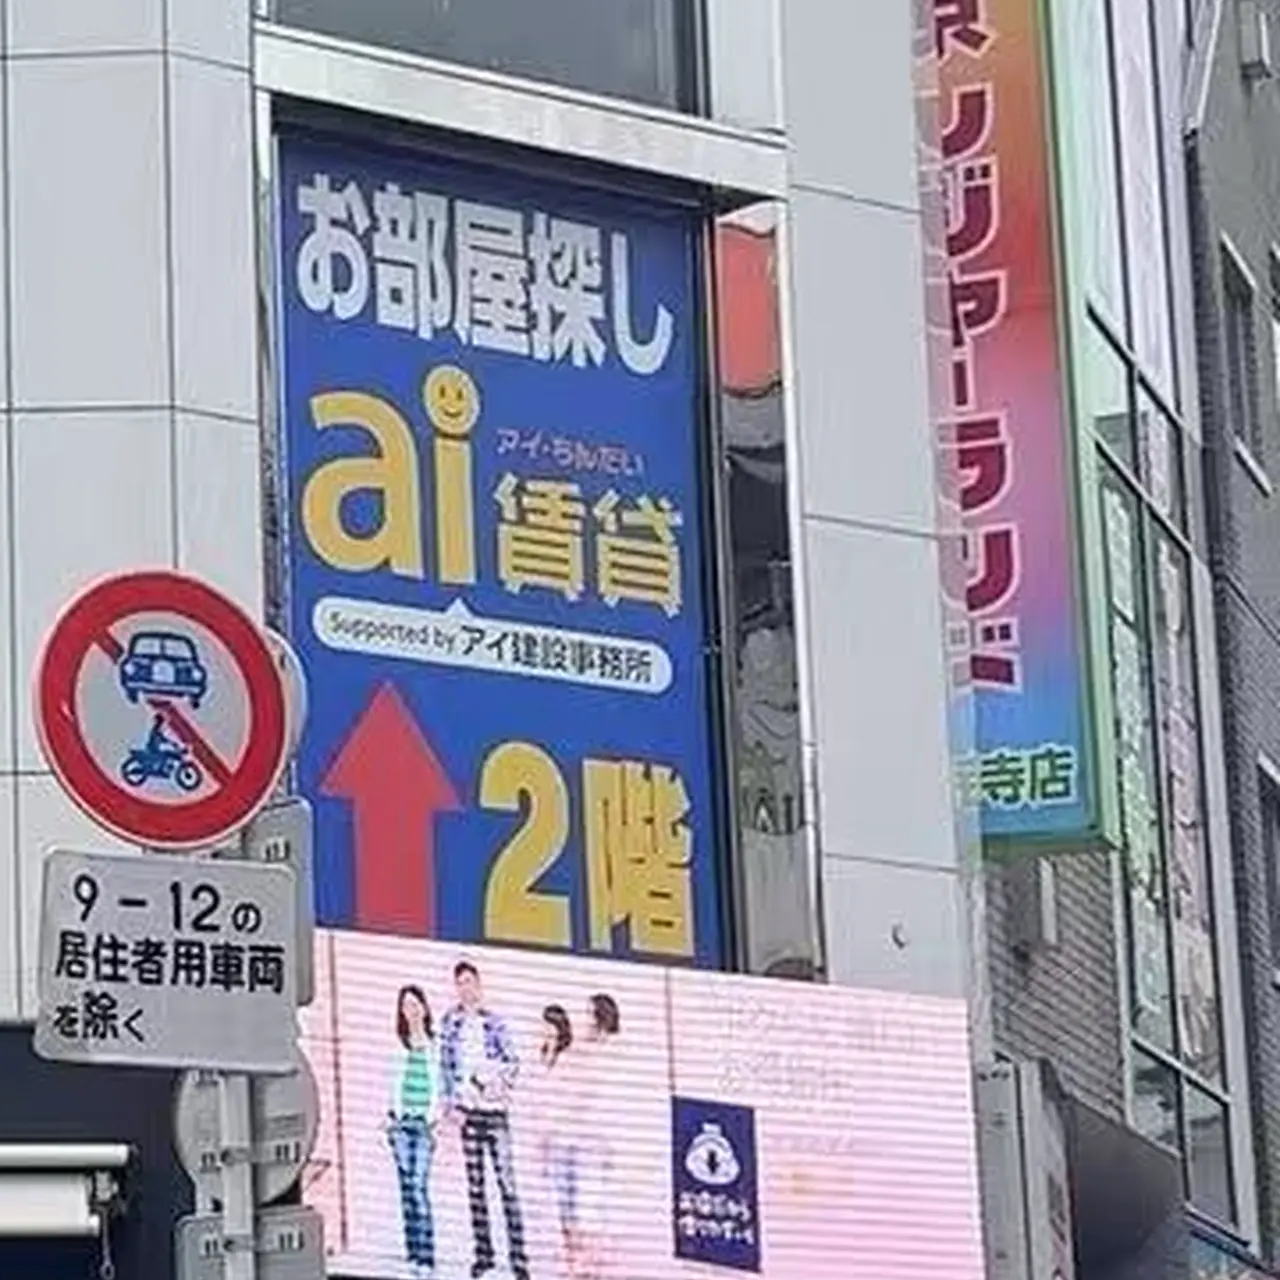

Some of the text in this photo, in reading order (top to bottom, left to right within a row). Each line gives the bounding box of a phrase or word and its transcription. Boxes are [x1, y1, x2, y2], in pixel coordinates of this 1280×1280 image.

[296, 172, 675, 375] お部屋探し
[301, 363, 684, 619] ai 賃貸
[327, 610, 430, 646] Supported
[459, 624, 654, 685] アイ建設事務所
[478, 741, 696, 957] 2階
[53, 994, 146, 1043] を除く
[55, 930, 286, 996] 居住者用車両
